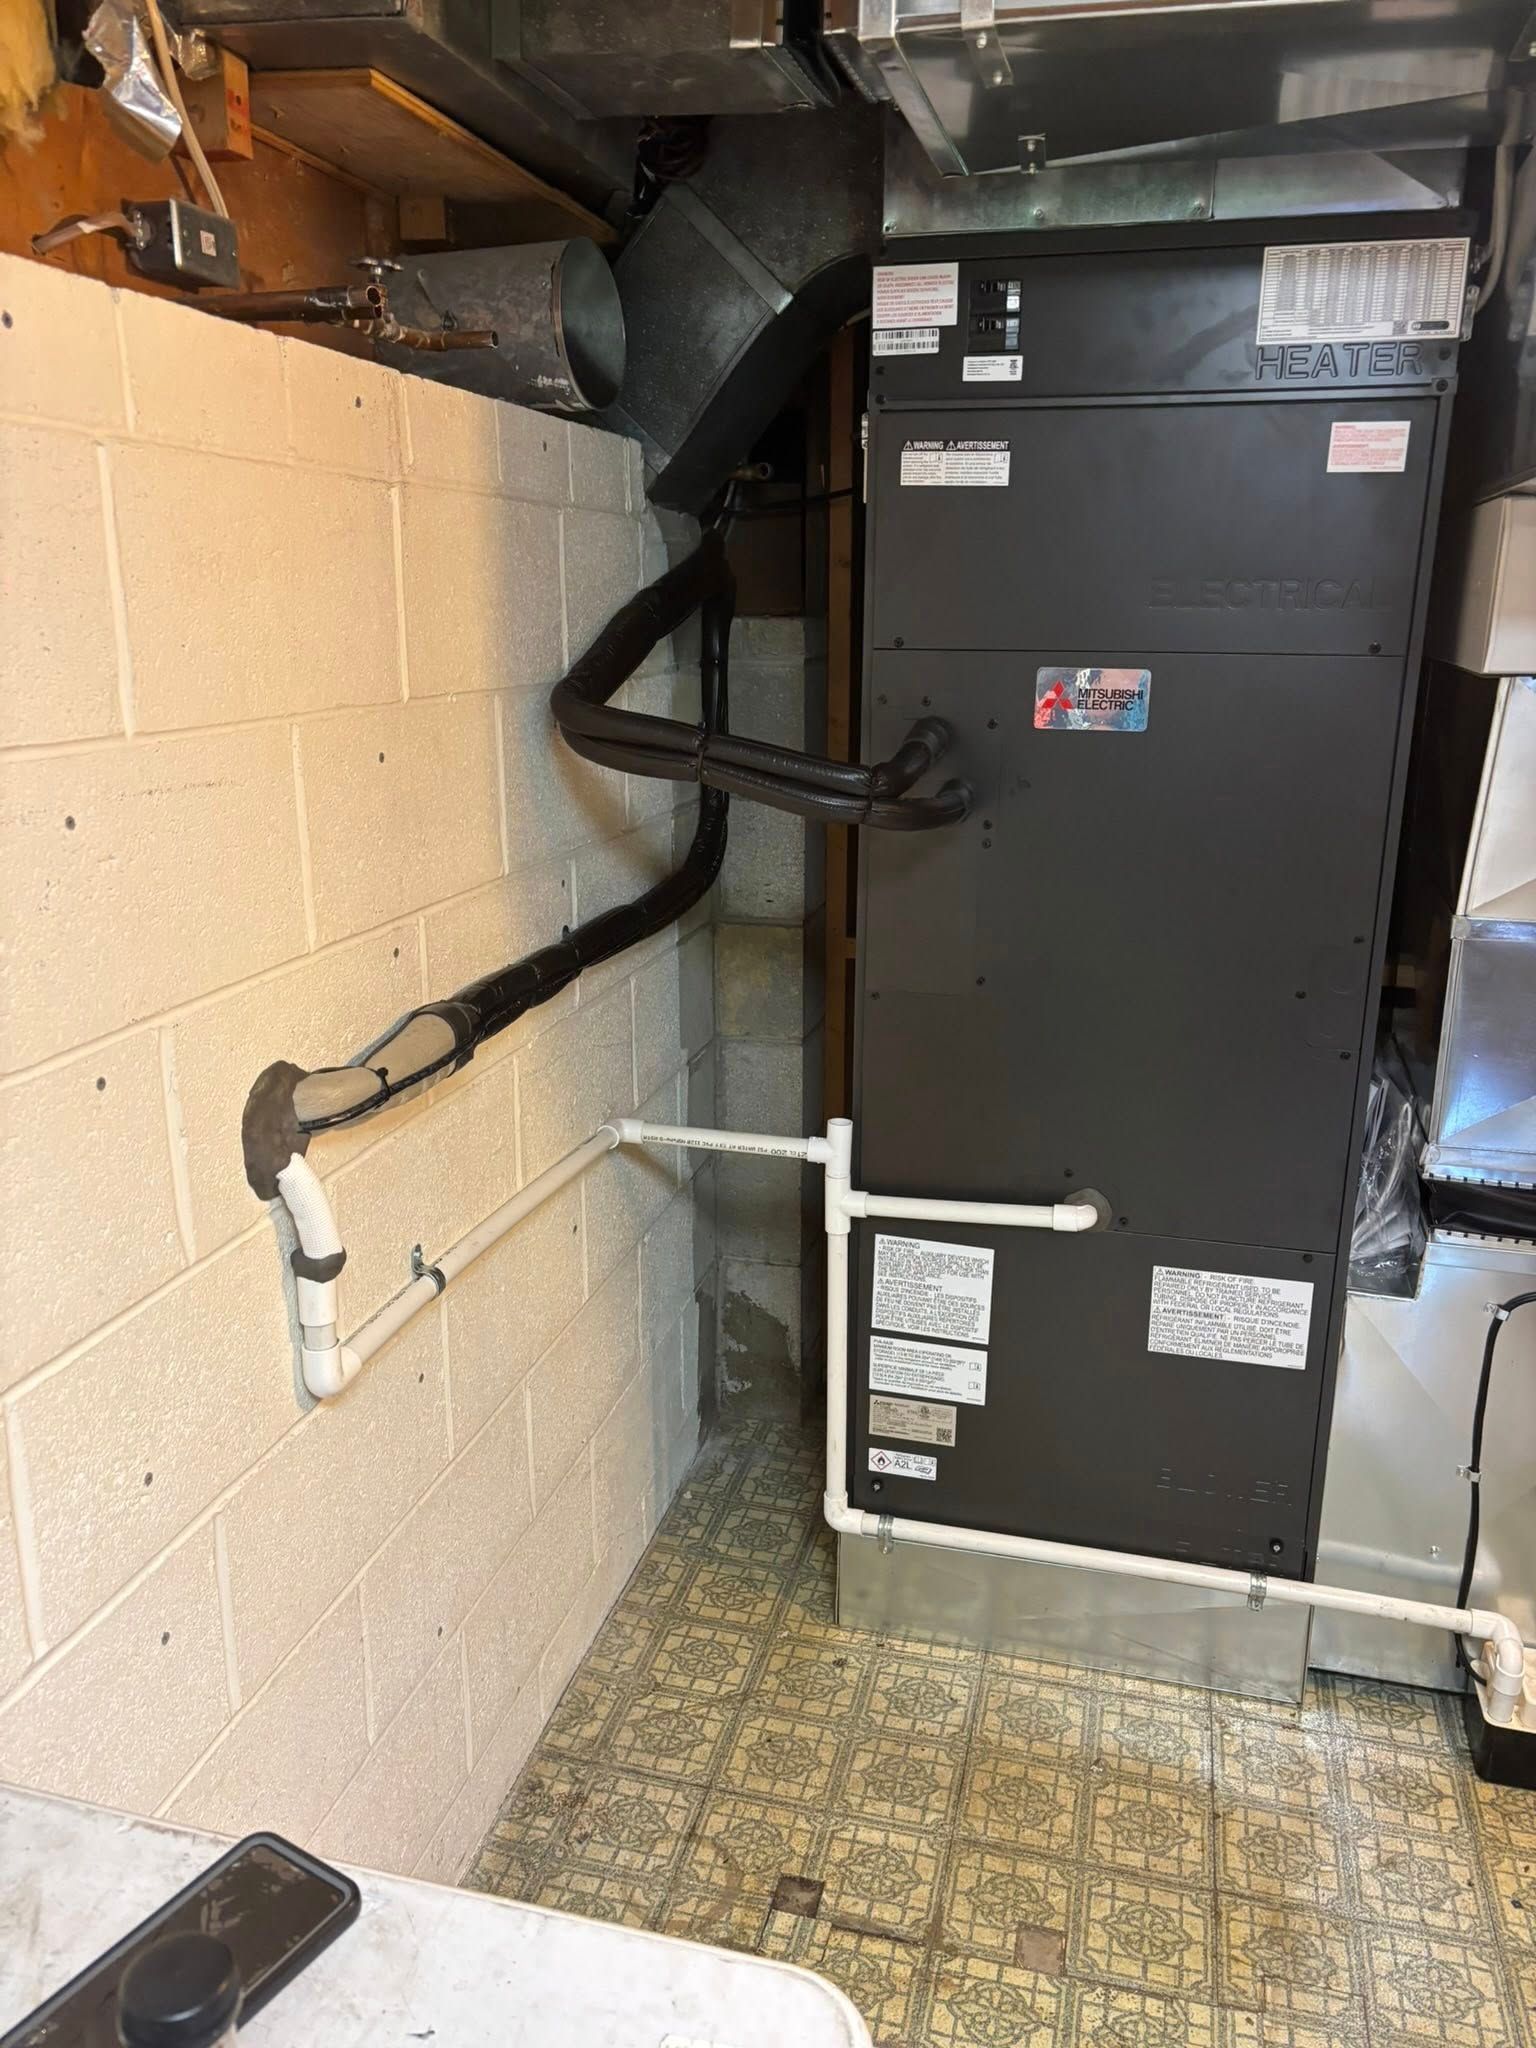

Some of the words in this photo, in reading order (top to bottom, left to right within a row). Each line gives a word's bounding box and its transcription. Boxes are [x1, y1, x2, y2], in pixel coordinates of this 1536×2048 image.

[1255, 342, 1422, 380] HEATER
[913, 441, 944, 450] WARNING
[956, 441, 1009, 450] AVERTISSEMENT
[1148, 577, 1392, 612] ELECTRICAL
[1077, 688, 1144, 699] MITSUBISHI
[1077, 699, 1134, 710] ELECTRIC
[886, 1238, 920, 1249] WARNING
[947, 1254, 969, 1262] DEVICES
[1164, 1269, 1200, 1278] WARNING
[884, 1278, 942, 1292] AVERTISSEMENT
[1153, 1275, 1192, 1284] FLAMMABLE
[1193, 1279, 1239, 1290] REFRIGERANT
[1153, 1281, 1185, 1289] REPAIRED
[1215, 1287, 1242, 1296] TRAINED
[1243, 1291, 1272, 1299] SERVICE
[1171, 1300, 1198, 1309] FEDERAL
[1179, 1295, 1207, 1303] DISPOSE
[1219, 1300, 1253, 1308] PROPERLY
[1262, 1305, 1307, 1314] ACCORDANCE
[1220, 1294, 1255, 1303] PUNCTURE
[1257, 1298, 1303, 1308] REFRIGERANT
[1162, 1307, 1223, 1319] AVERTISSEMENT
[1233, 1315, 1259, 1323] RISQUE
[1239, 1330, 1276, 1339] PERSONNEL
[1259, 1325, 1273, 1333] DOIT
[1274, 1327, 1291, 1335] ÊTRE
[894, 1460, 912, 1470] A2L
